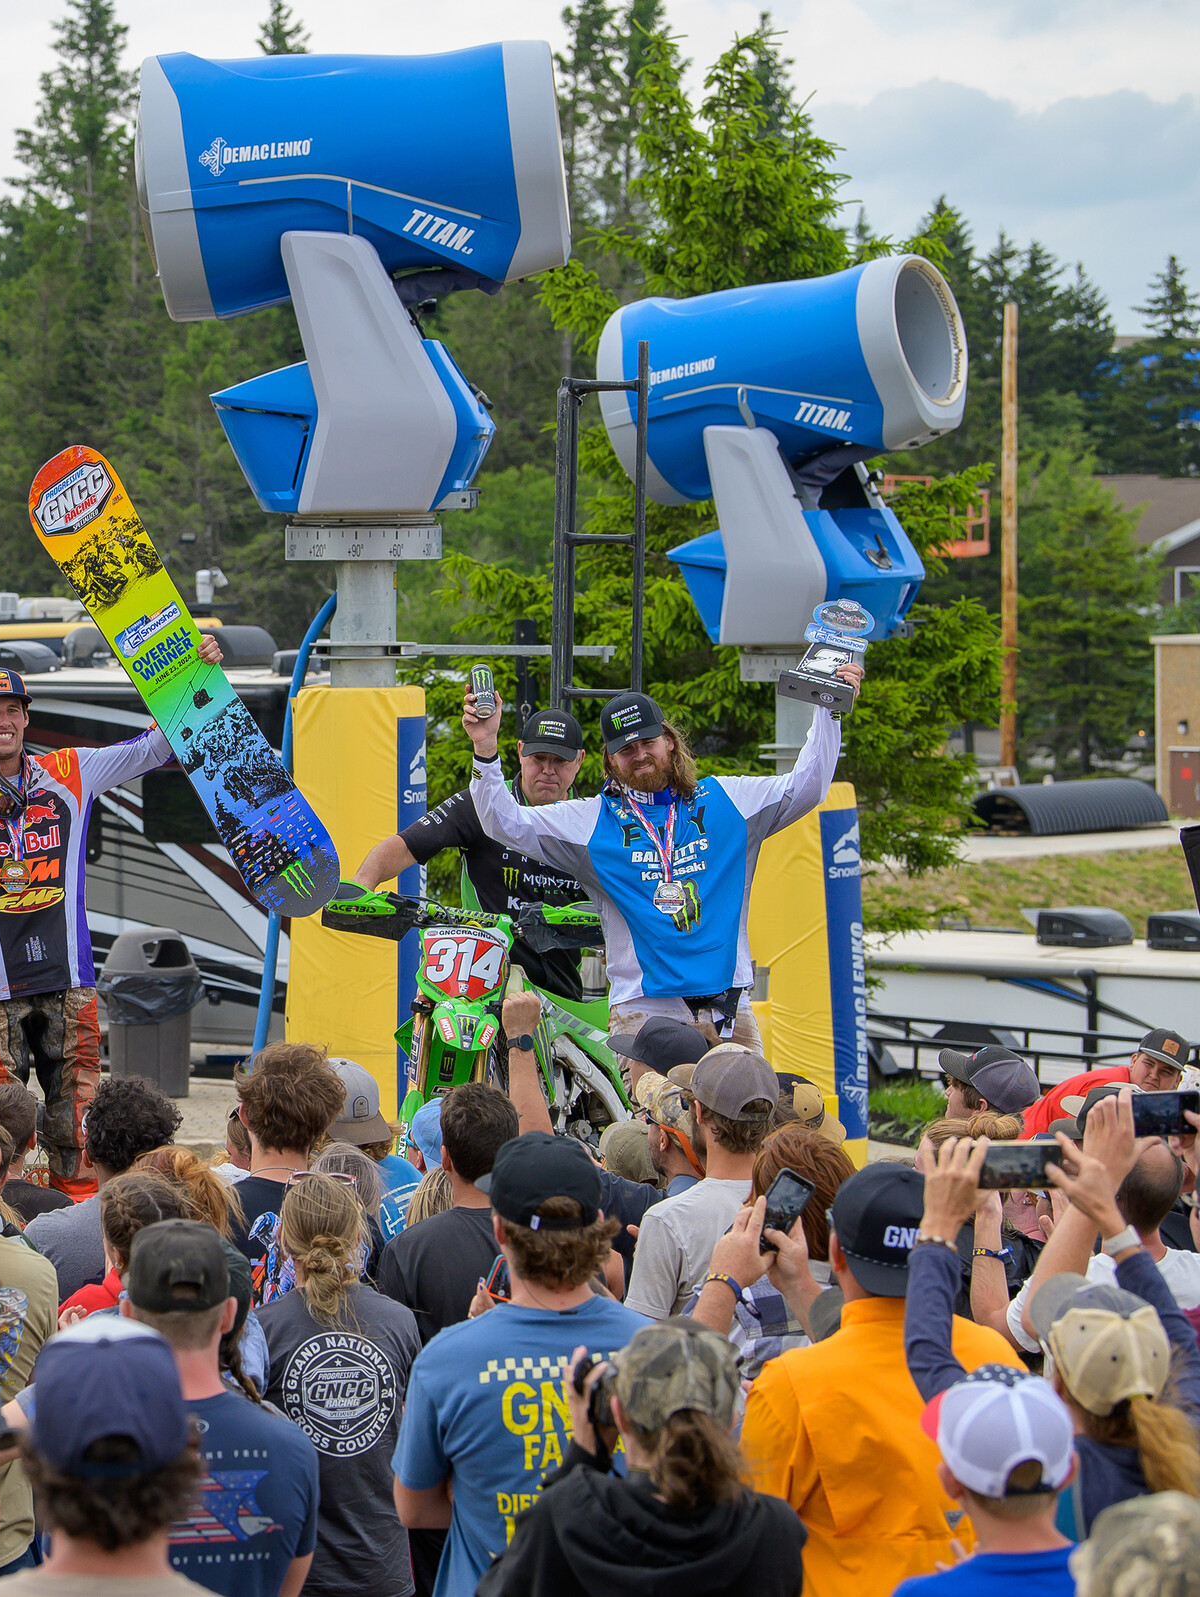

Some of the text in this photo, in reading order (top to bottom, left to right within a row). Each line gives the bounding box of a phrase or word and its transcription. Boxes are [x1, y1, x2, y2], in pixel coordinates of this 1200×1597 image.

[223, 140, 312, 165] DEMACLENKO
[402, 208, 476, 251] TITAN
[649, 357, 716, 387] DEMACLENKO
[794, 401, 851, 430] TITAN
[42, 468, 104, 526] GNCC
[45, 467, 85, 501] PROGRESSIVE
[64, 493, 97, 524] RACING
[347, 543, 365, 558] +90°
[388, 543, 404, 558] +60°
[140, 607, 179, 637] Snowshoe
[132, 626, 192, 673] OVERALL
[828, 635, 864, 649] Snowshoe
[140, 637, 194, 682] WINNER
[154, 671, 171, 685] JUNE
[179, 654, 192, 668] 2024
[25, 824, 61, 853] Bull
[523, 873, 581, 890] MONSTE
[329, 903, 377, 914] ACERBIS
[426, 937, 504, 990] 314
[850, 921, 868, 1083] DEMACLENKO
[440, 1018, 454, 1040] MOTUL
[480, 1025, 494, 1046] MOTUL
[287, 1336, 391, 1390] GRAND NATIONAL
[318, 1371, 360, 1380] PROGRESSIVE
[286, 1387, 393, 1404] 20 24
[307, 1379, 375, 1402] GNCC
[325, 1398, 360, 1409] RACING
[290, 1402, 391, 1452] CROSS COUNTRY
